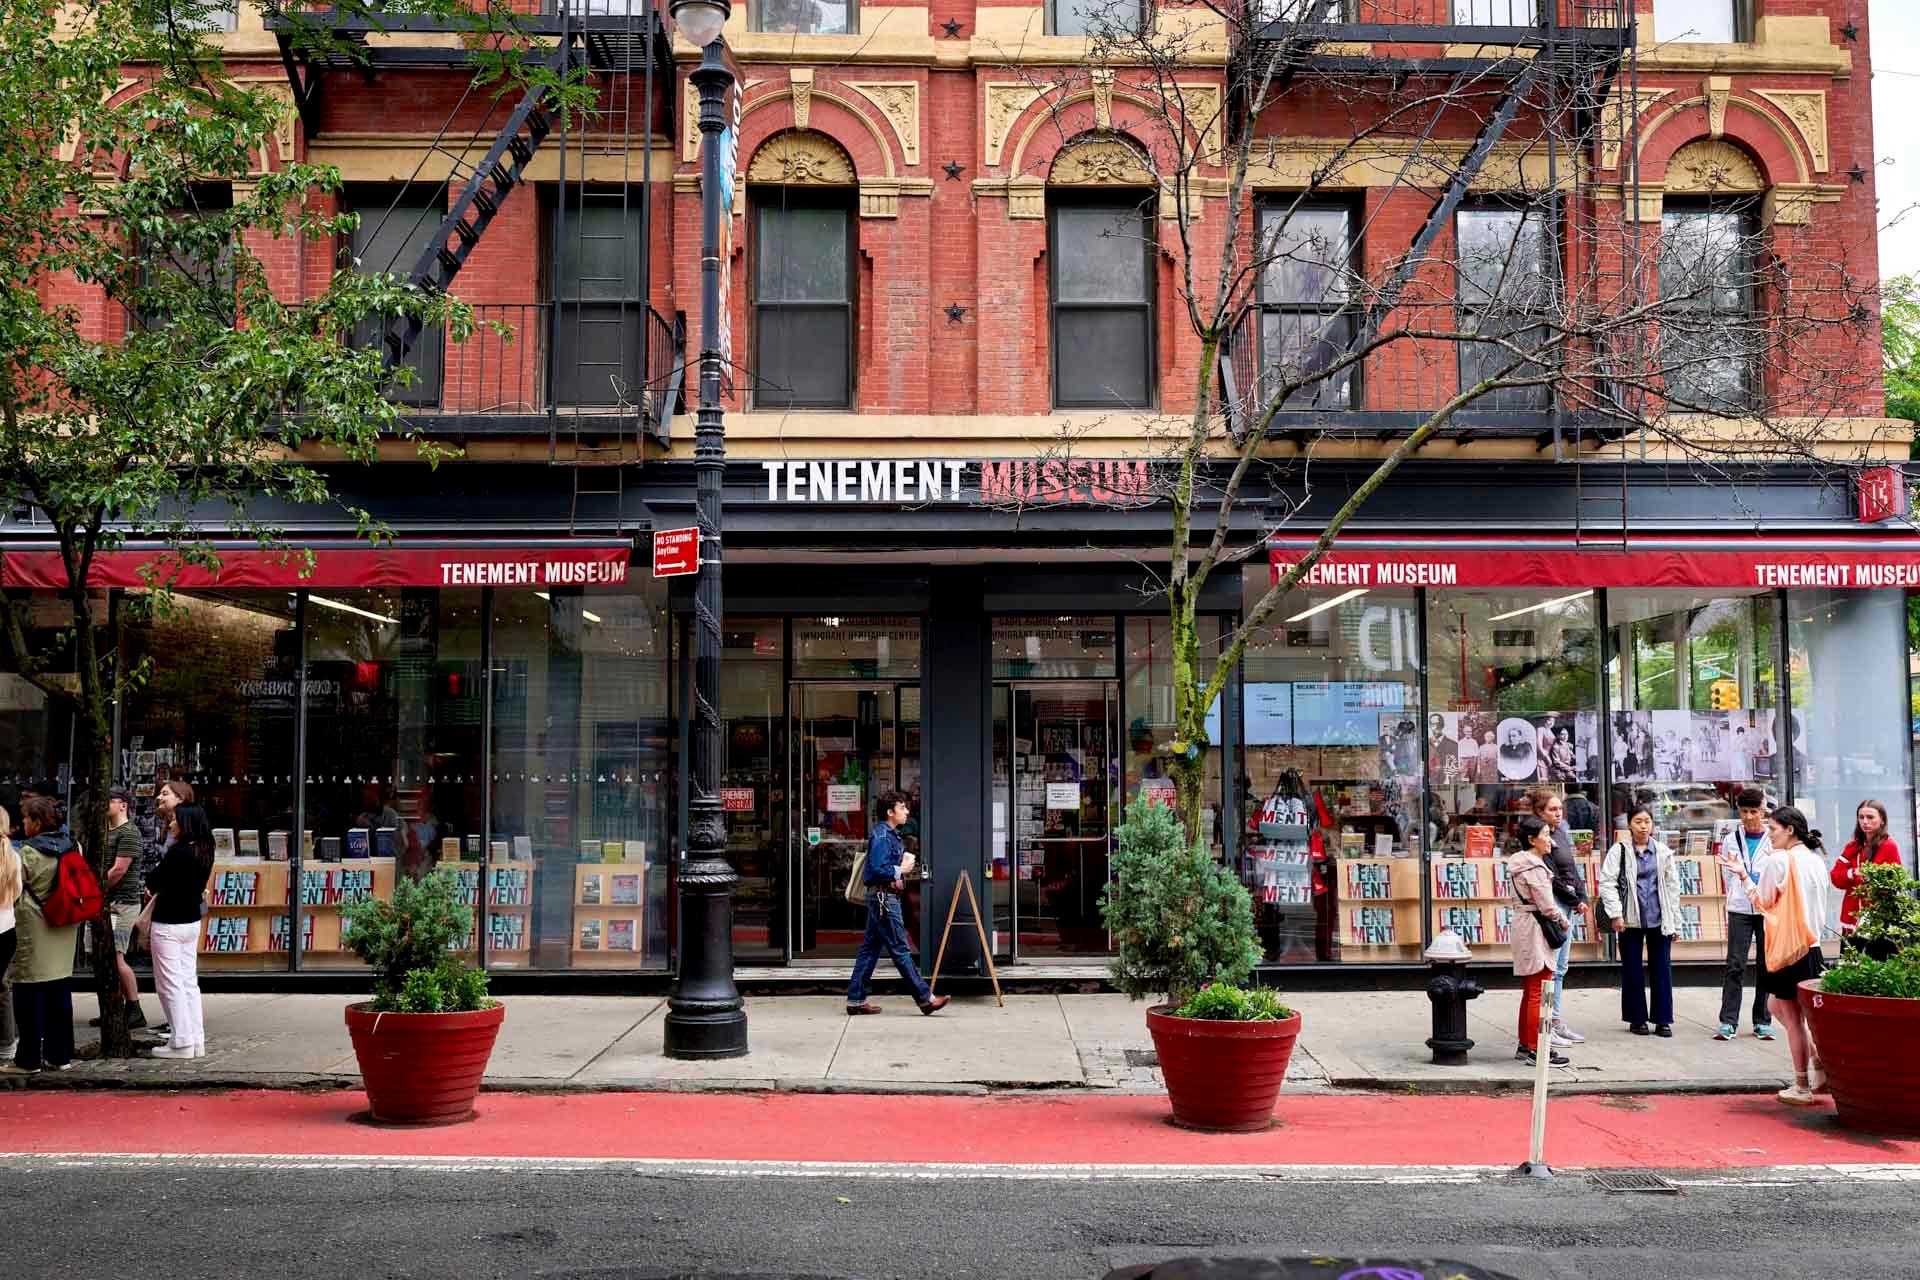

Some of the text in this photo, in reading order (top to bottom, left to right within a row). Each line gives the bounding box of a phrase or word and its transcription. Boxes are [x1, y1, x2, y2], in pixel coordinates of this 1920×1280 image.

[762, 460, 1149, 501] TENEMENT MUSEUM
[656, 533, 692, 545] NO STANDING
[656, 546, 679, 557] Anytime
[440, 561, 626, 584] TENEMENT MUSEUM
[1377, 563, 1457, 584] MUSEUM
[1755, 564, 1920, 585] TENEMENT MUSEU
[1261, 811, 1307, 824] MENT
[1263, 850, 1308, 864] MENT
[212, 888, 257, 905] MENT
[1263, 886, 1311, 903] MENT
[1349, 881, 1390, 898] MENT
[1436, 881, 1479, 897] MENT
[204, 935, 248, 951] MENT
[1352, 926, 1394, 944] MENT
[1450, 926, 1483, 944] ENT
